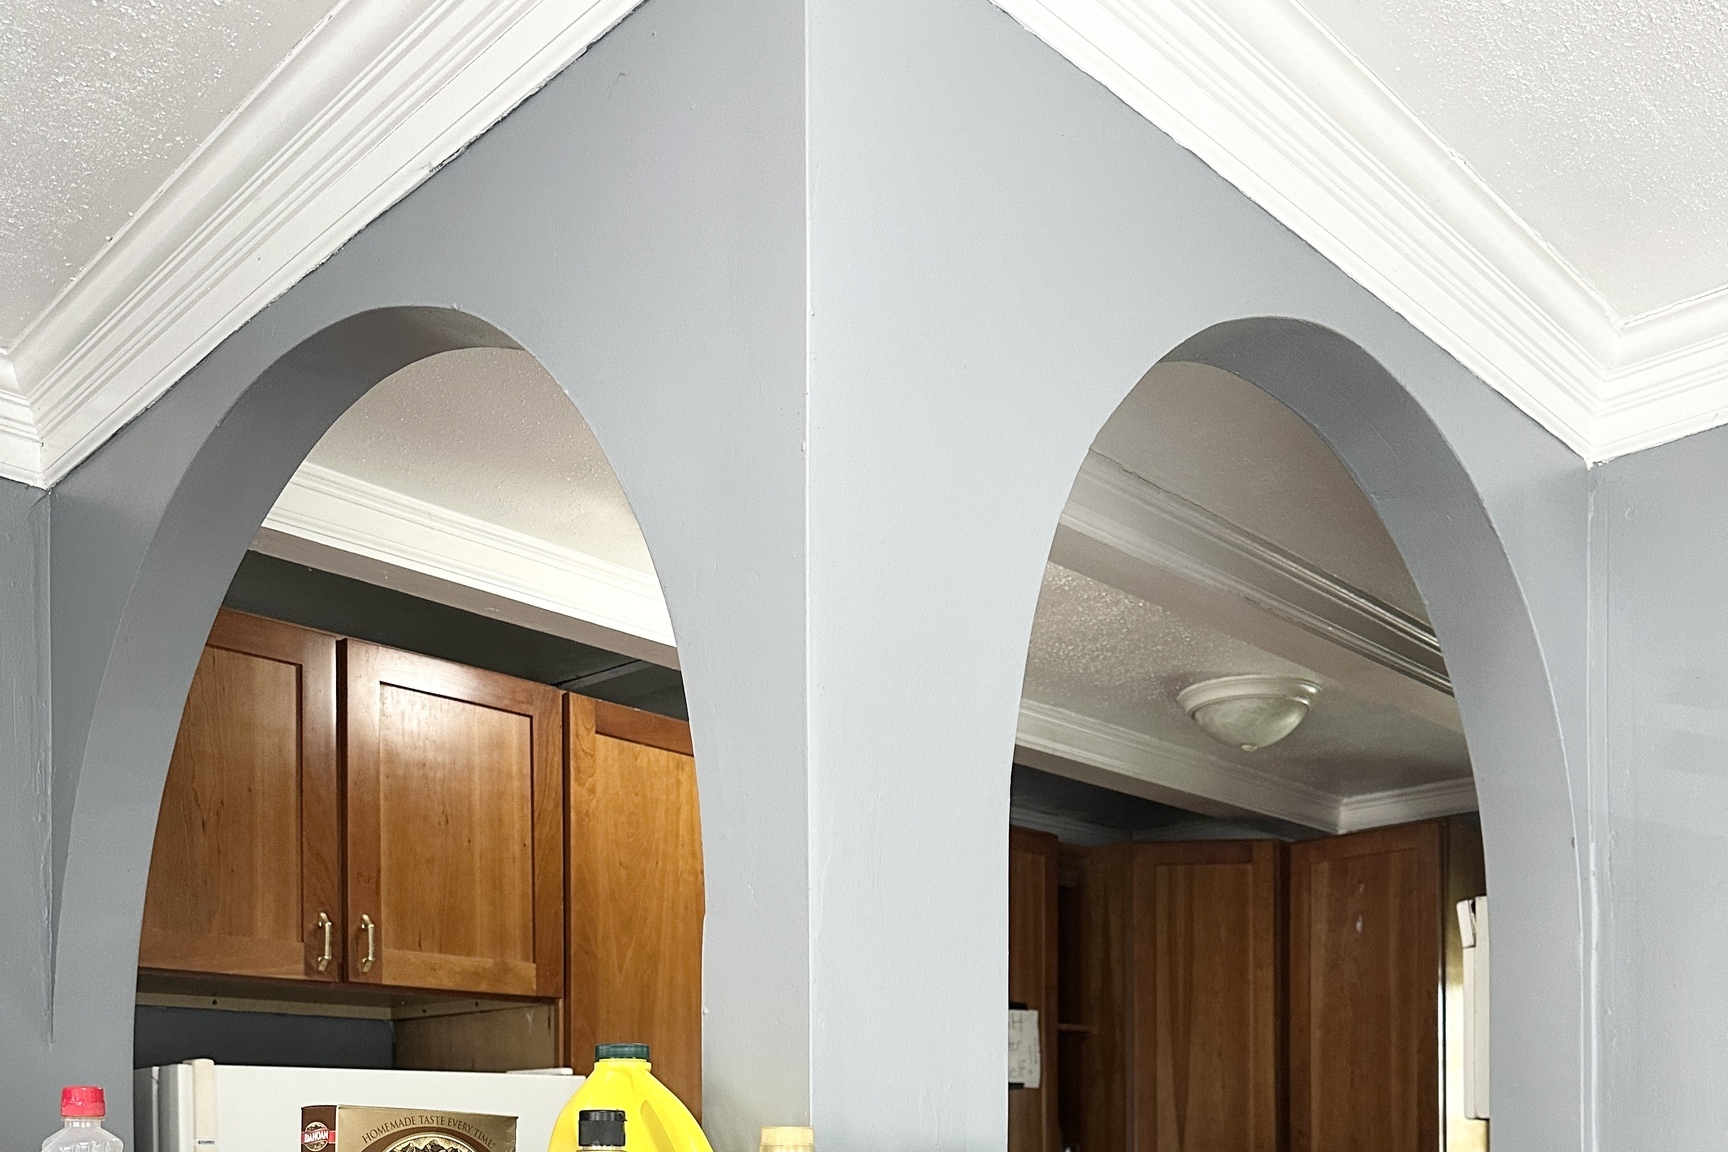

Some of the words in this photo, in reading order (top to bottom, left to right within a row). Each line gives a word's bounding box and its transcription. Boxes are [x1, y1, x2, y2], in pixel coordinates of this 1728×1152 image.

[304, 1130, 329, 1143] IDAHOAN
[361, 1115, 417, 1144] HOMEMADE
[419, 1115, 446, 1126] TASTE
[447, 1117, 475, 1134] EVERY
